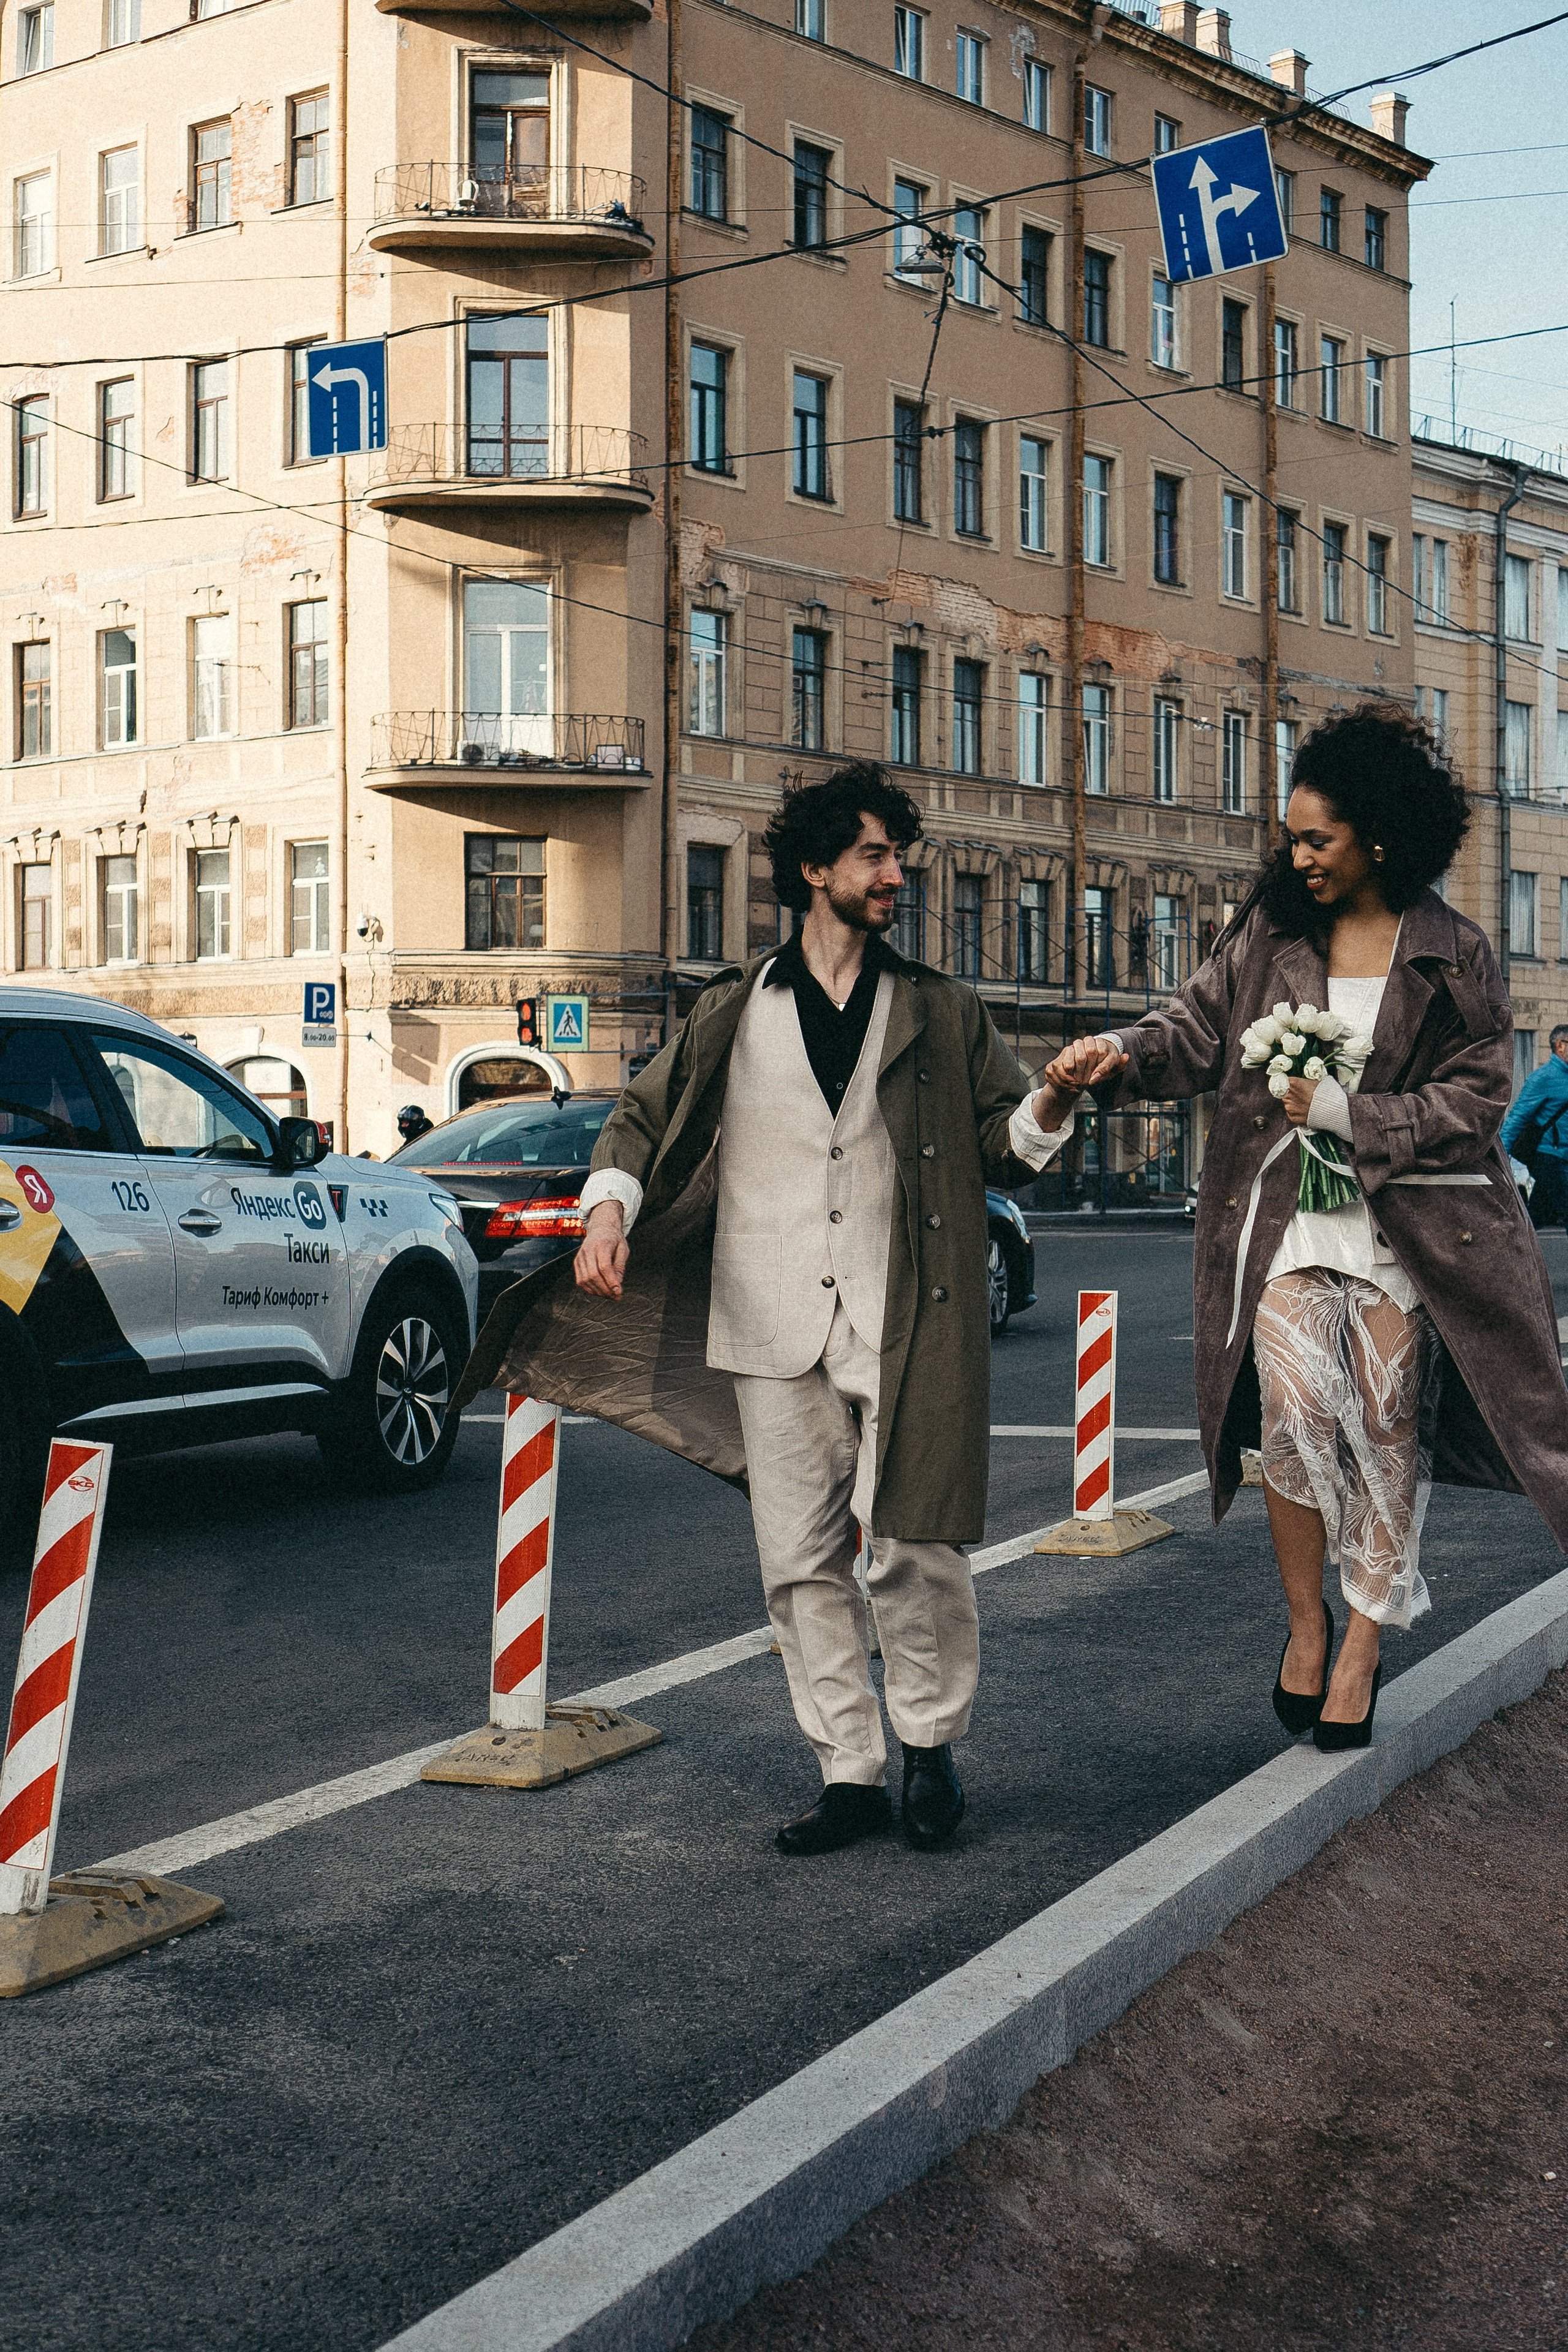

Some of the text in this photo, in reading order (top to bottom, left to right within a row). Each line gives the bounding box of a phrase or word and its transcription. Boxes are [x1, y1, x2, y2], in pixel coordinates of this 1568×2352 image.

[312, 986, 330, 1019] P
[111, 1181, 150, 1212] 126
[230, 1187, 323, 1221] Яндекс Go
[284, 1233, 330, 1264] Такси
[222, 1285, 262, 1310] Тариф
[263, 1286, 320, 1310] Комфорт
